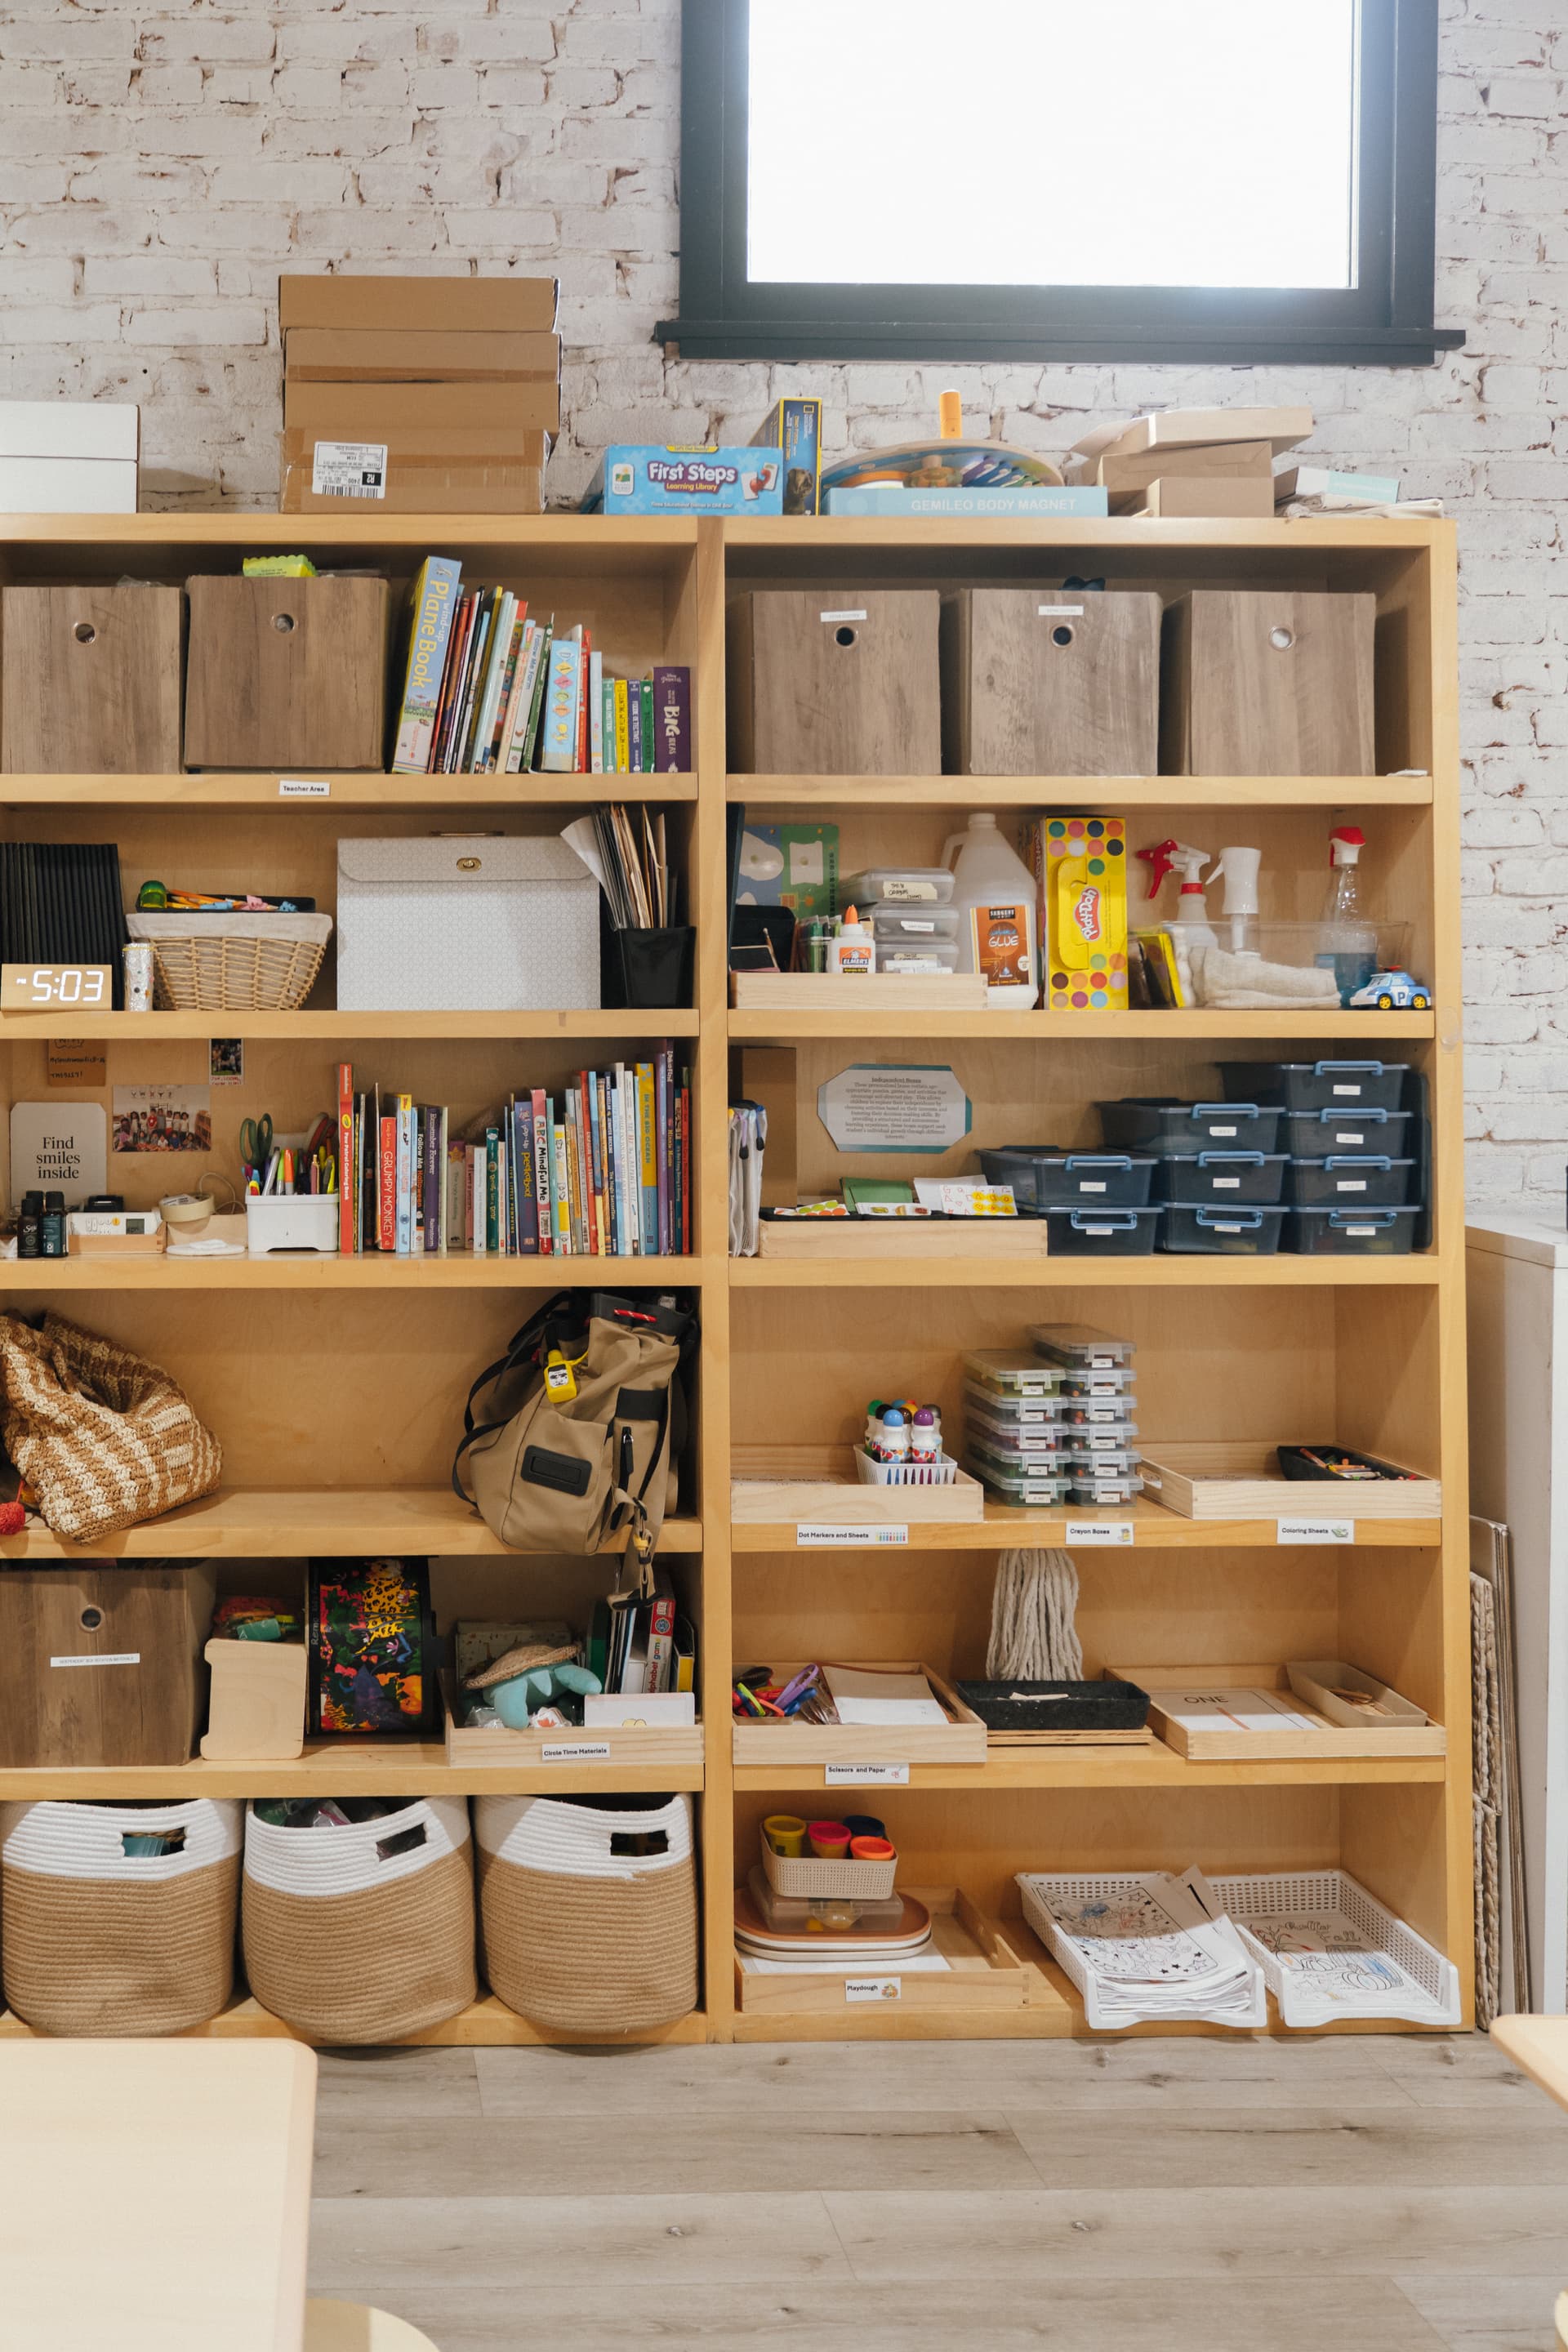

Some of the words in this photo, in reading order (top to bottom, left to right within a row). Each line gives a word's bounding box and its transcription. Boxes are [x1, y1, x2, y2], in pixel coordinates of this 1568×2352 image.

[648, 462, 685, 481] First
[688, 461, 736, 483] Steps
[666, 483, 694, 492] Learning
[695, 483, 717, 492] Library
[911, 499, 973, 510] GEMILEO
[977, 499, 1014, 510] BODY
[1018, 498, 1076, 510] MAGNET
[421, 579, 448, 635] Plane
[435, 603, 450, 642] wind-up
[412, 639, 437, 688] Book
[663, 706, 680, 737] BIG
[1079, 889, 1098, 940] Play-Doh
[988, 935, 1019, 947] GLUE
[32, 970, 104, 1001] 5:03
[1397, 991, 1405, 1004] P
[644, 1094, 650, 1102] IN
[43, 1136, 74, 1149] Find
[521, 1125, 529, 1149] pop-up
[537, 1121, 546, 1145] ABC
[36, 1151, 80, 1164] smiles
[417, 1158, 424, 1169] Me
[539, 1147, 547, 1183] Mindful
[38, 1165, 79, 1178] inside
[384, 1152, 393, 1192] GRUMPY
[540, 1187, 547, 1200] Me
[384, 1195, 393, 1237] MONKEY
